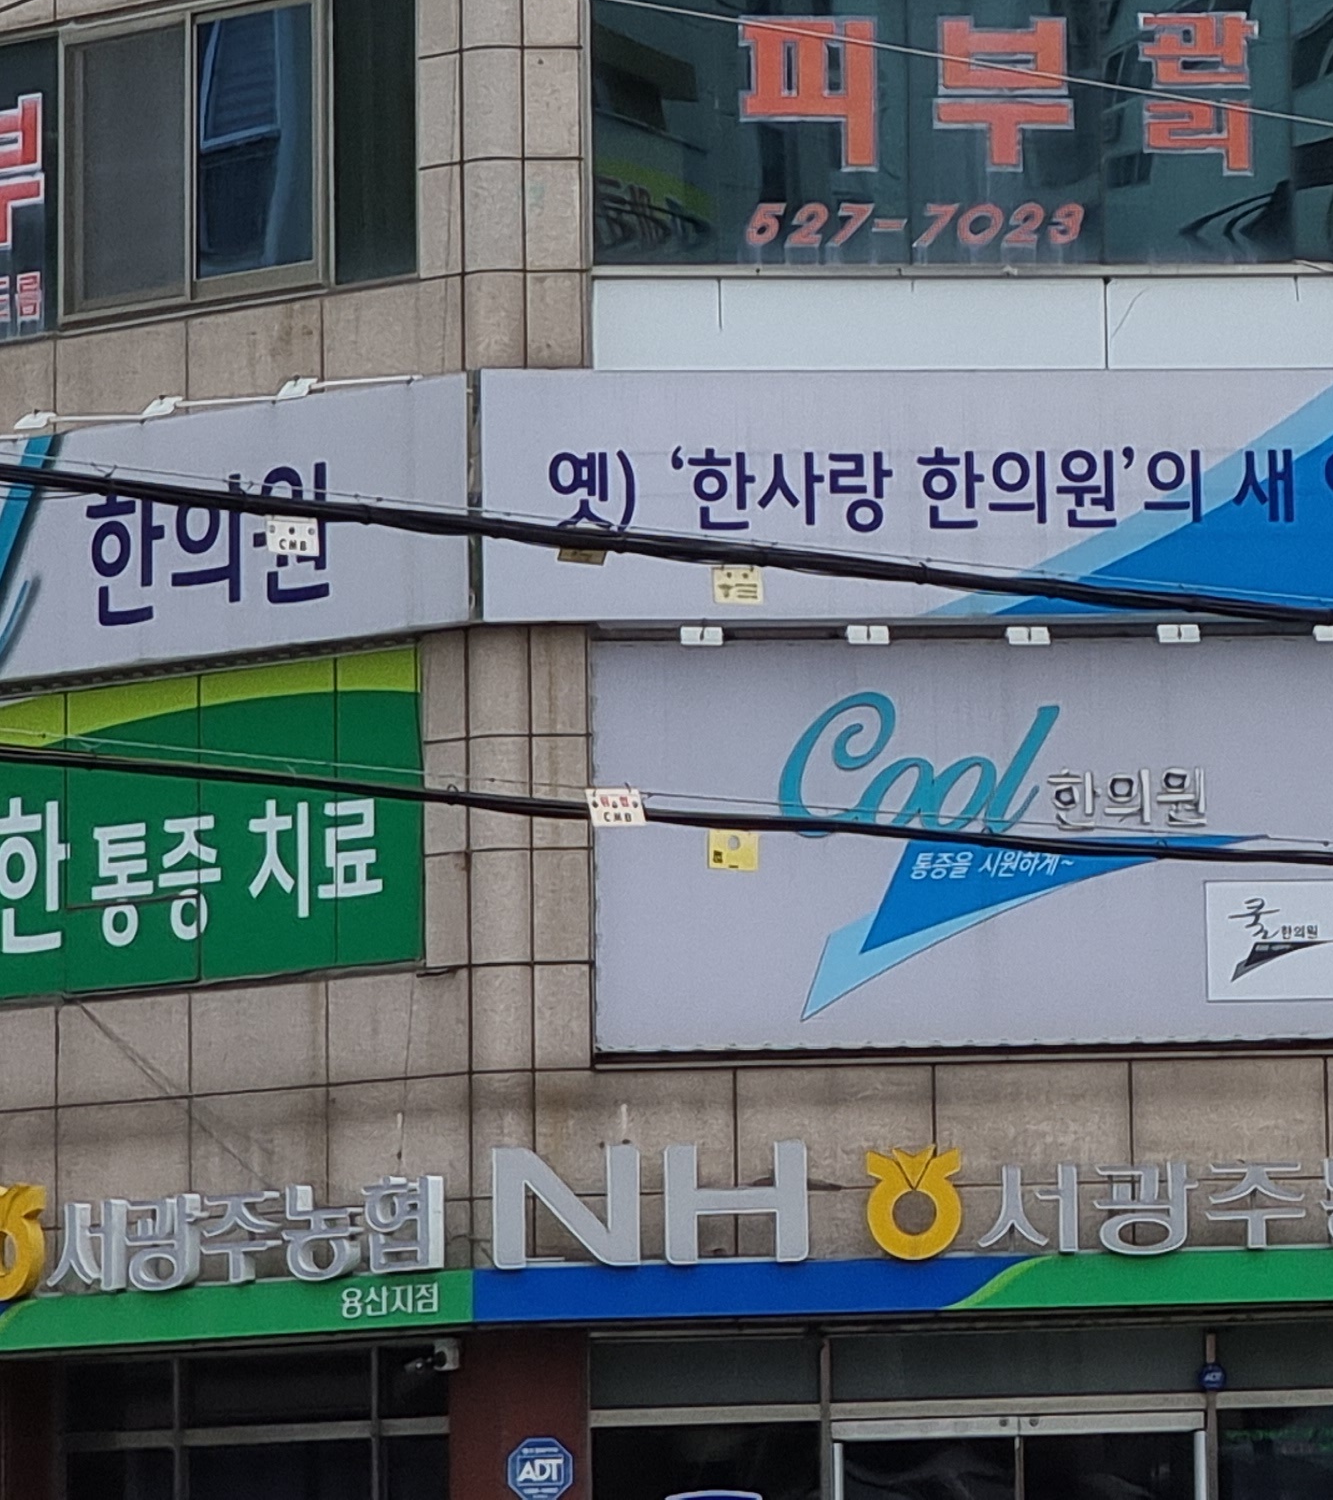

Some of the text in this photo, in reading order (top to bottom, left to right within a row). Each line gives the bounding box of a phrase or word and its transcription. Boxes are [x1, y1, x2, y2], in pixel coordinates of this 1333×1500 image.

[745, 201, 1086, 248] 527-7023
[1231, 446, 1298, 524] 새
[86, 461, 331, 626] 한의원
[778, 690, 1209, 838] Cool 한의원
[91, 814, 223, 948] 통증
[248, 798, 384, 919] 치료
[909, 851, 973, 882] 통증을
[46, 1174, 446, 1292] 서광주농협
[491, 1139, 809, 1270] NH
[340, 1281, 440, 1320] 용산지점
[516, 1458, 564, 1482] ADT
